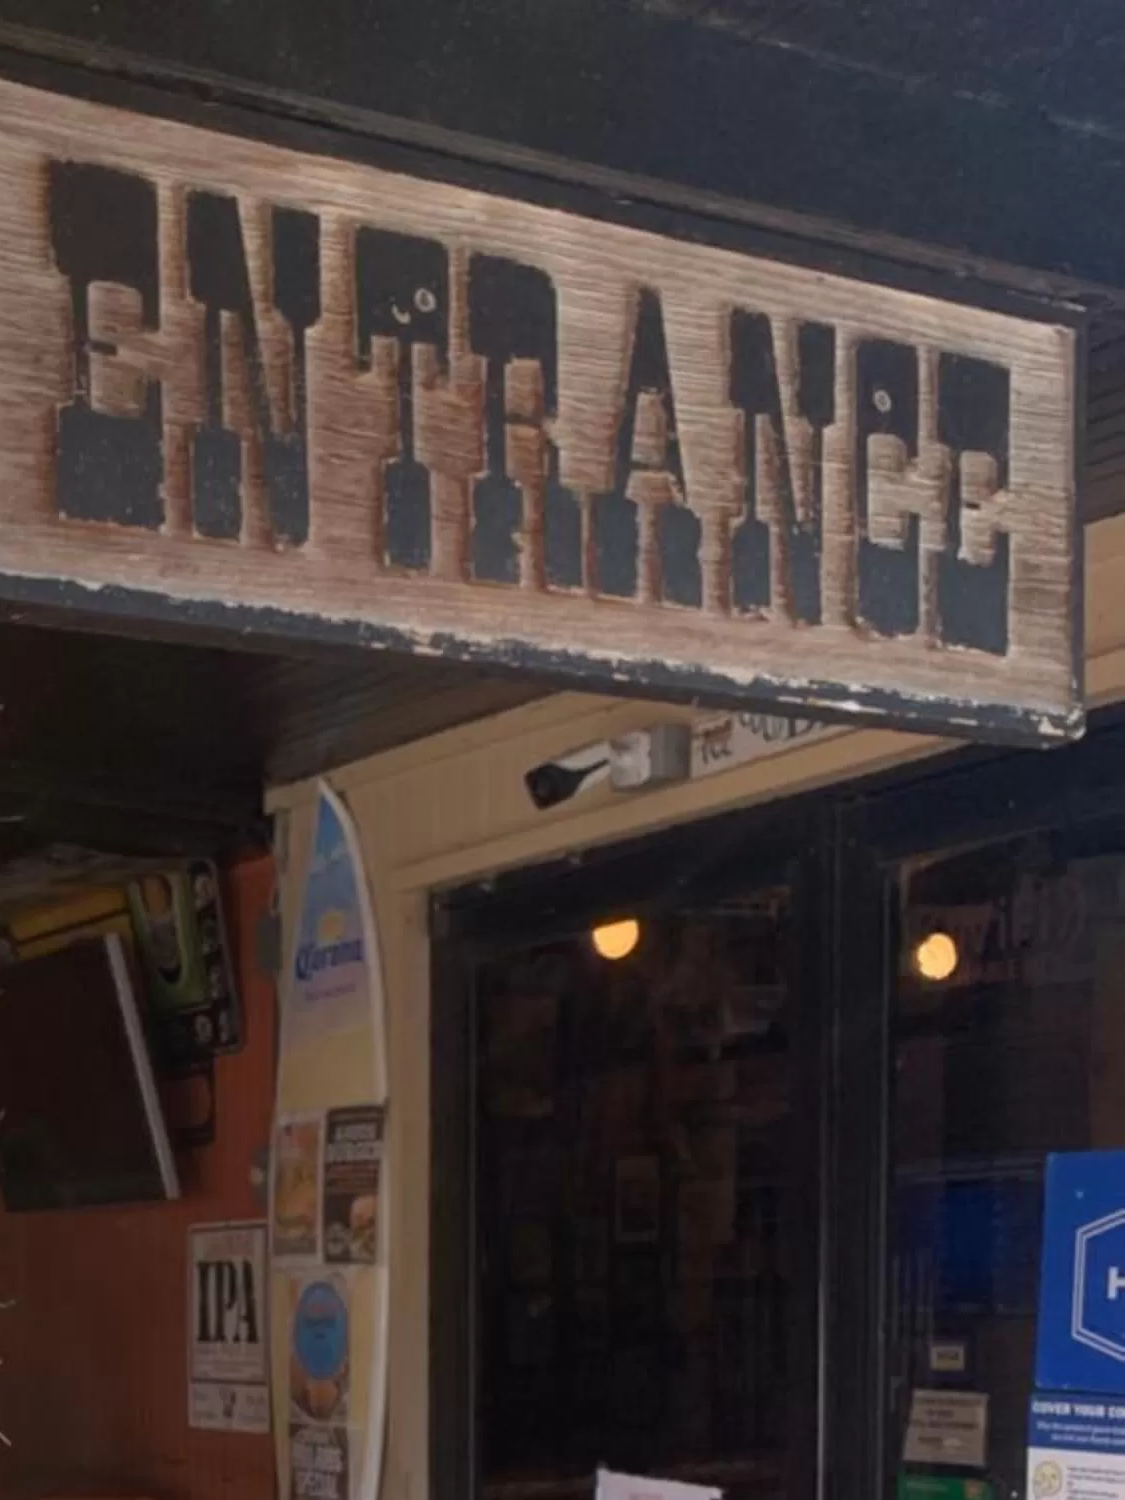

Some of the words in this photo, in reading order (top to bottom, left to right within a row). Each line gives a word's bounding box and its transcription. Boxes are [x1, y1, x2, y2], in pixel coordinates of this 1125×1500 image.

[43, 158, 1013, 656] ENTRANCE
[295, 937, 365, 982] Corona
[196, 1260, 259, 1345] IPA
[1031, 1401, 1071, 1415] COVER
